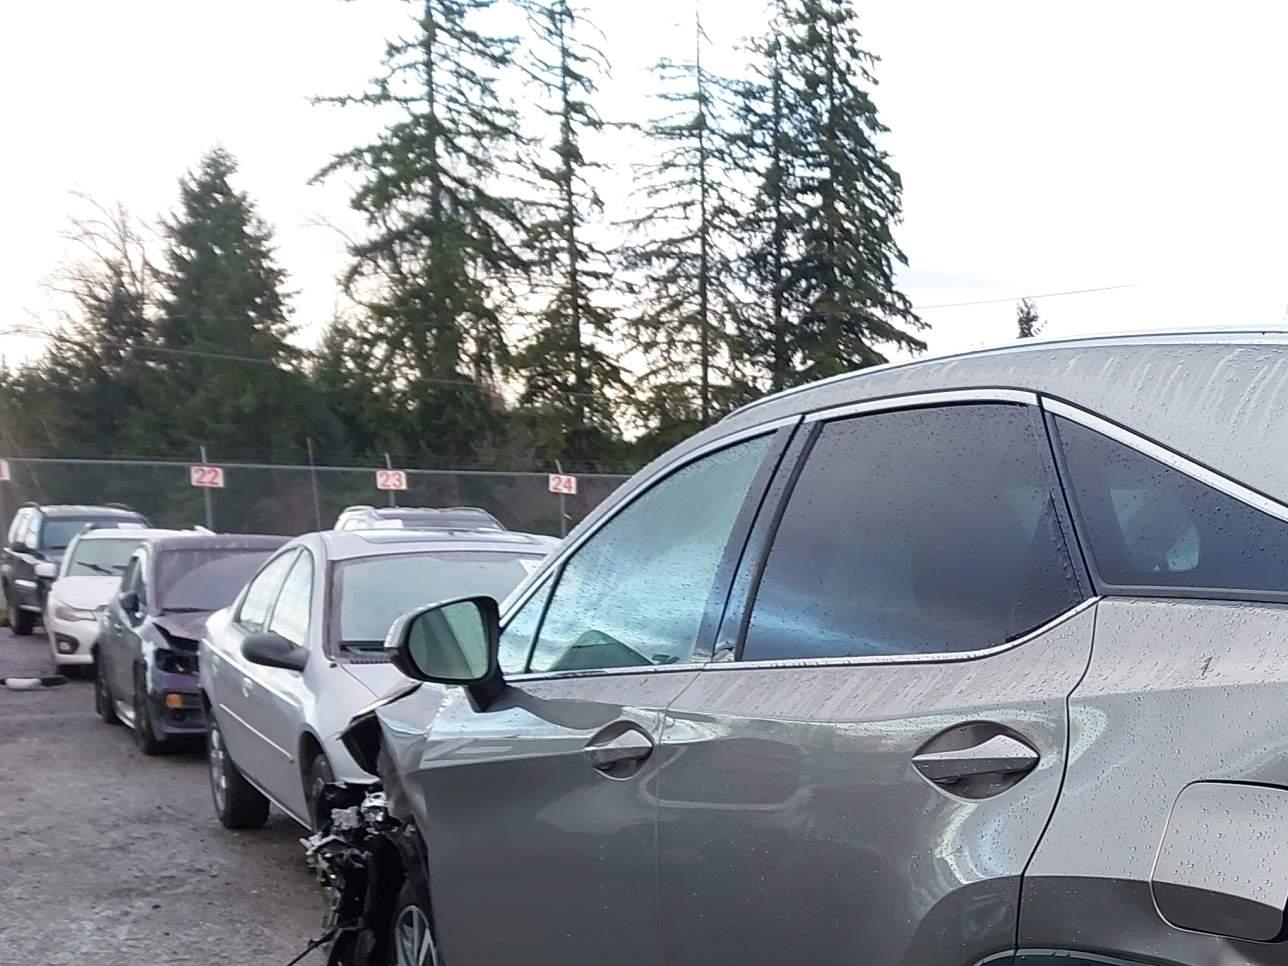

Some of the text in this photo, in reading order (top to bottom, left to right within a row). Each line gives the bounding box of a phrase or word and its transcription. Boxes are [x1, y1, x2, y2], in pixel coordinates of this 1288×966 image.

[193, 467, 220, 486] 22
[379, 471, 403, 489] 23
[552, 475, 574, 492] 24
